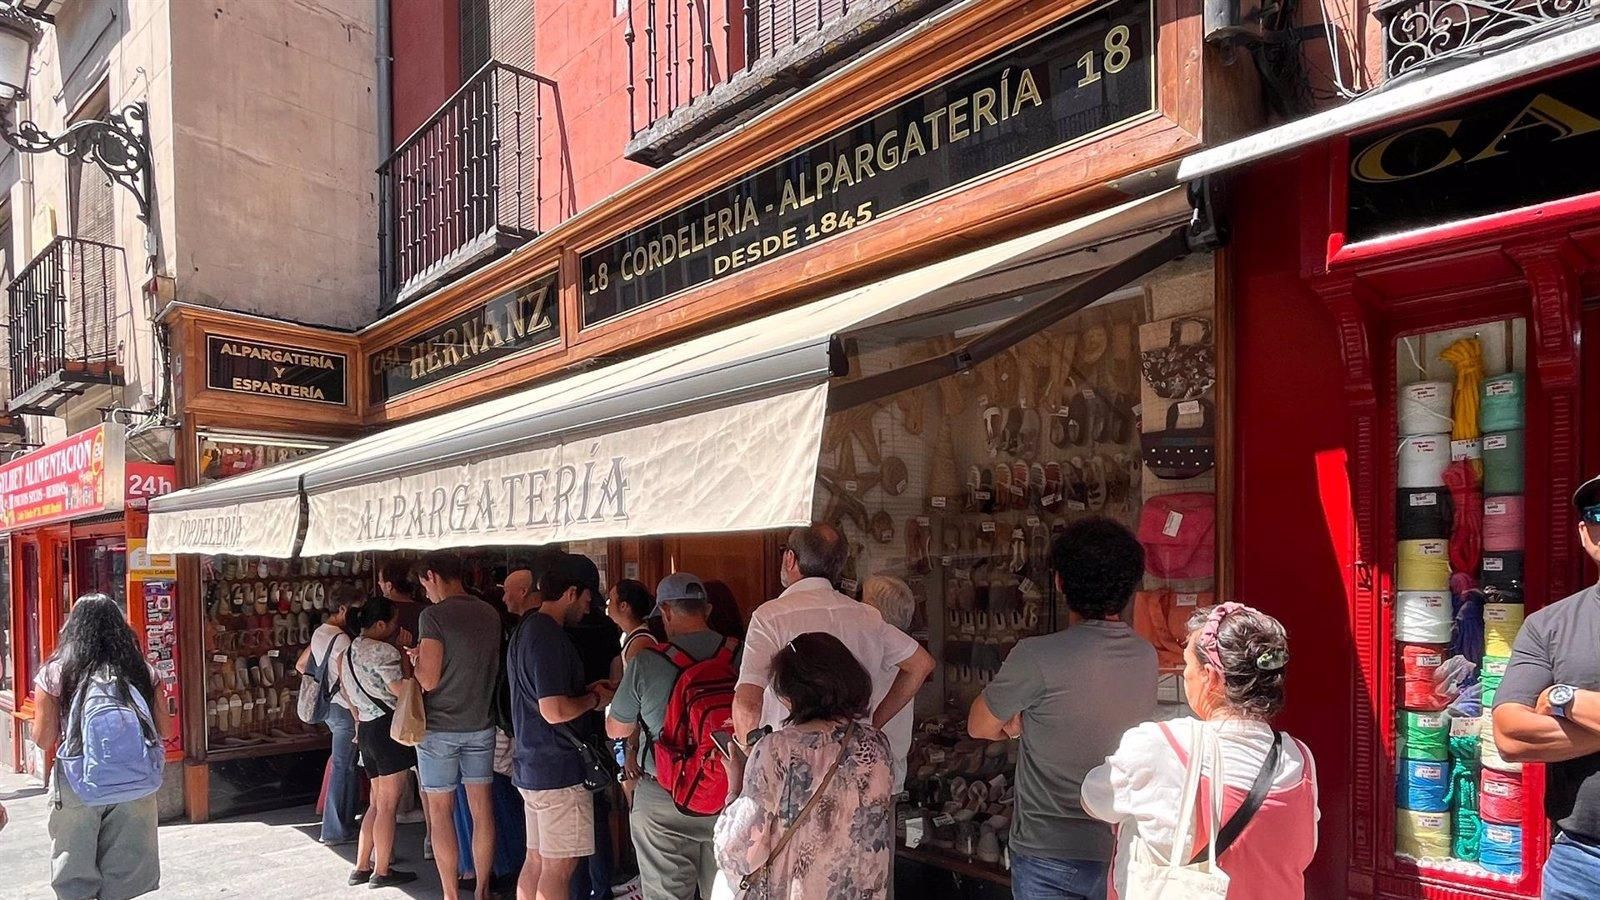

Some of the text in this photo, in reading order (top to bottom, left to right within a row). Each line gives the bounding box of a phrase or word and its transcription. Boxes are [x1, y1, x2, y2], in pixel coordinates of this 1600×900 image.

[588, 261, 609, 295] 18
[620, 194, 760, 282] CORDELERÍA
[778, 66, 1043, 216] ALPARGATERÍA
[1076, 24, 1132, 89] 18
[1350, 92, 1600, 184] CA
[714, 201, 875, 276] DESDE 1845
[220, 342, 335, 370] ALPARGATERÍA
[409, 286, 552, 380] HERNANZ
[232, 377, 325, 400] ESPARTERÍA
[273, 366, 286, 379] Y
[129, 474, 172, 495] 24h
[356, 442, 631, 542] ALPARGATERÍA
[178, 506, 243, 547] CORDELERÍA
